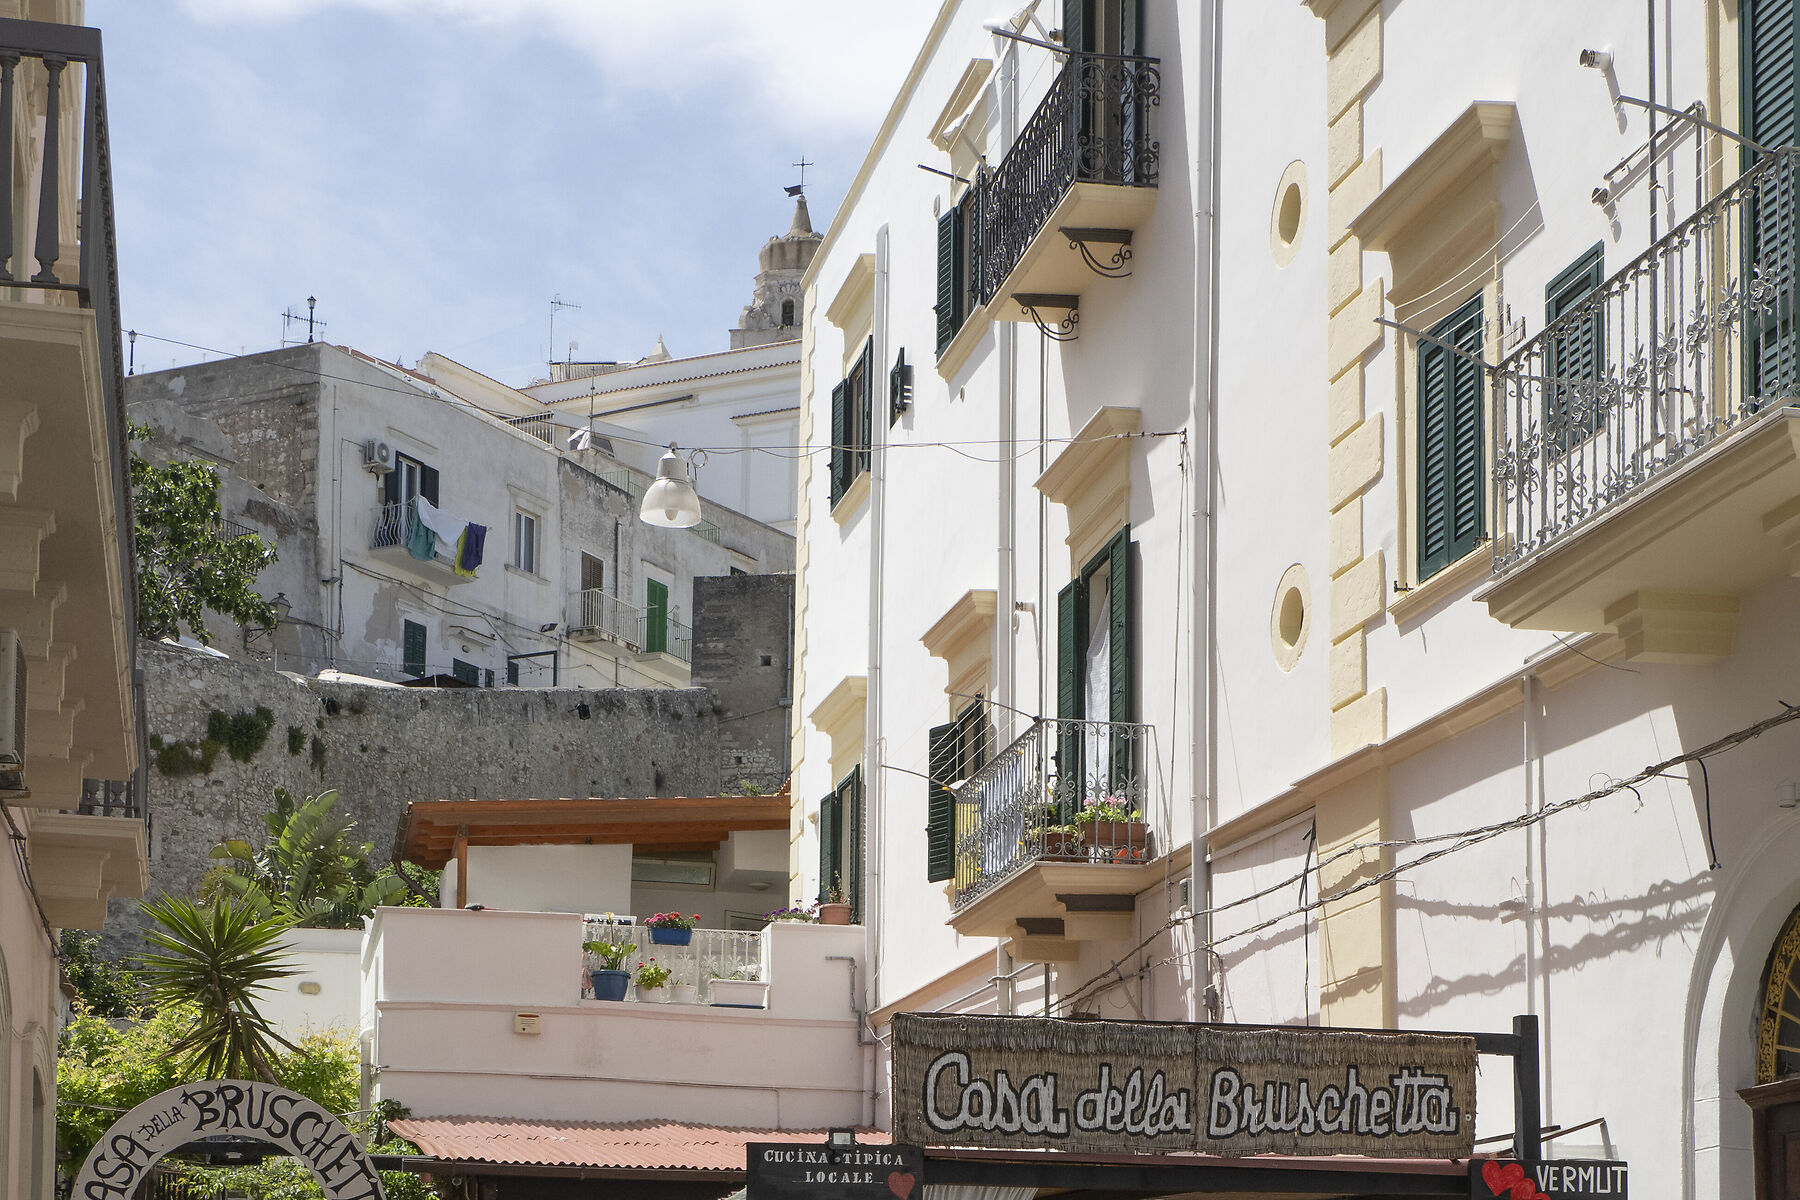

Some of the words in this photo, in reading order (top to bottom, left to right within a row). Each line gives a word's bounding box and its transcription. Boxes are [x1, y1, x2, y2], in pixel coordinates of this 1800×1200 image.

[922, 1050, 1069, 1139] Casa
[1073, 1063, 1191, 1138] della
[1207, 1065, 1460, 1139] Bruschetta
[138, 1105, 187, 1142] DELLA
[805, 1171, 873, 1184] LOCALE
[1536, 1165, 1627, 1193] VERMUT
